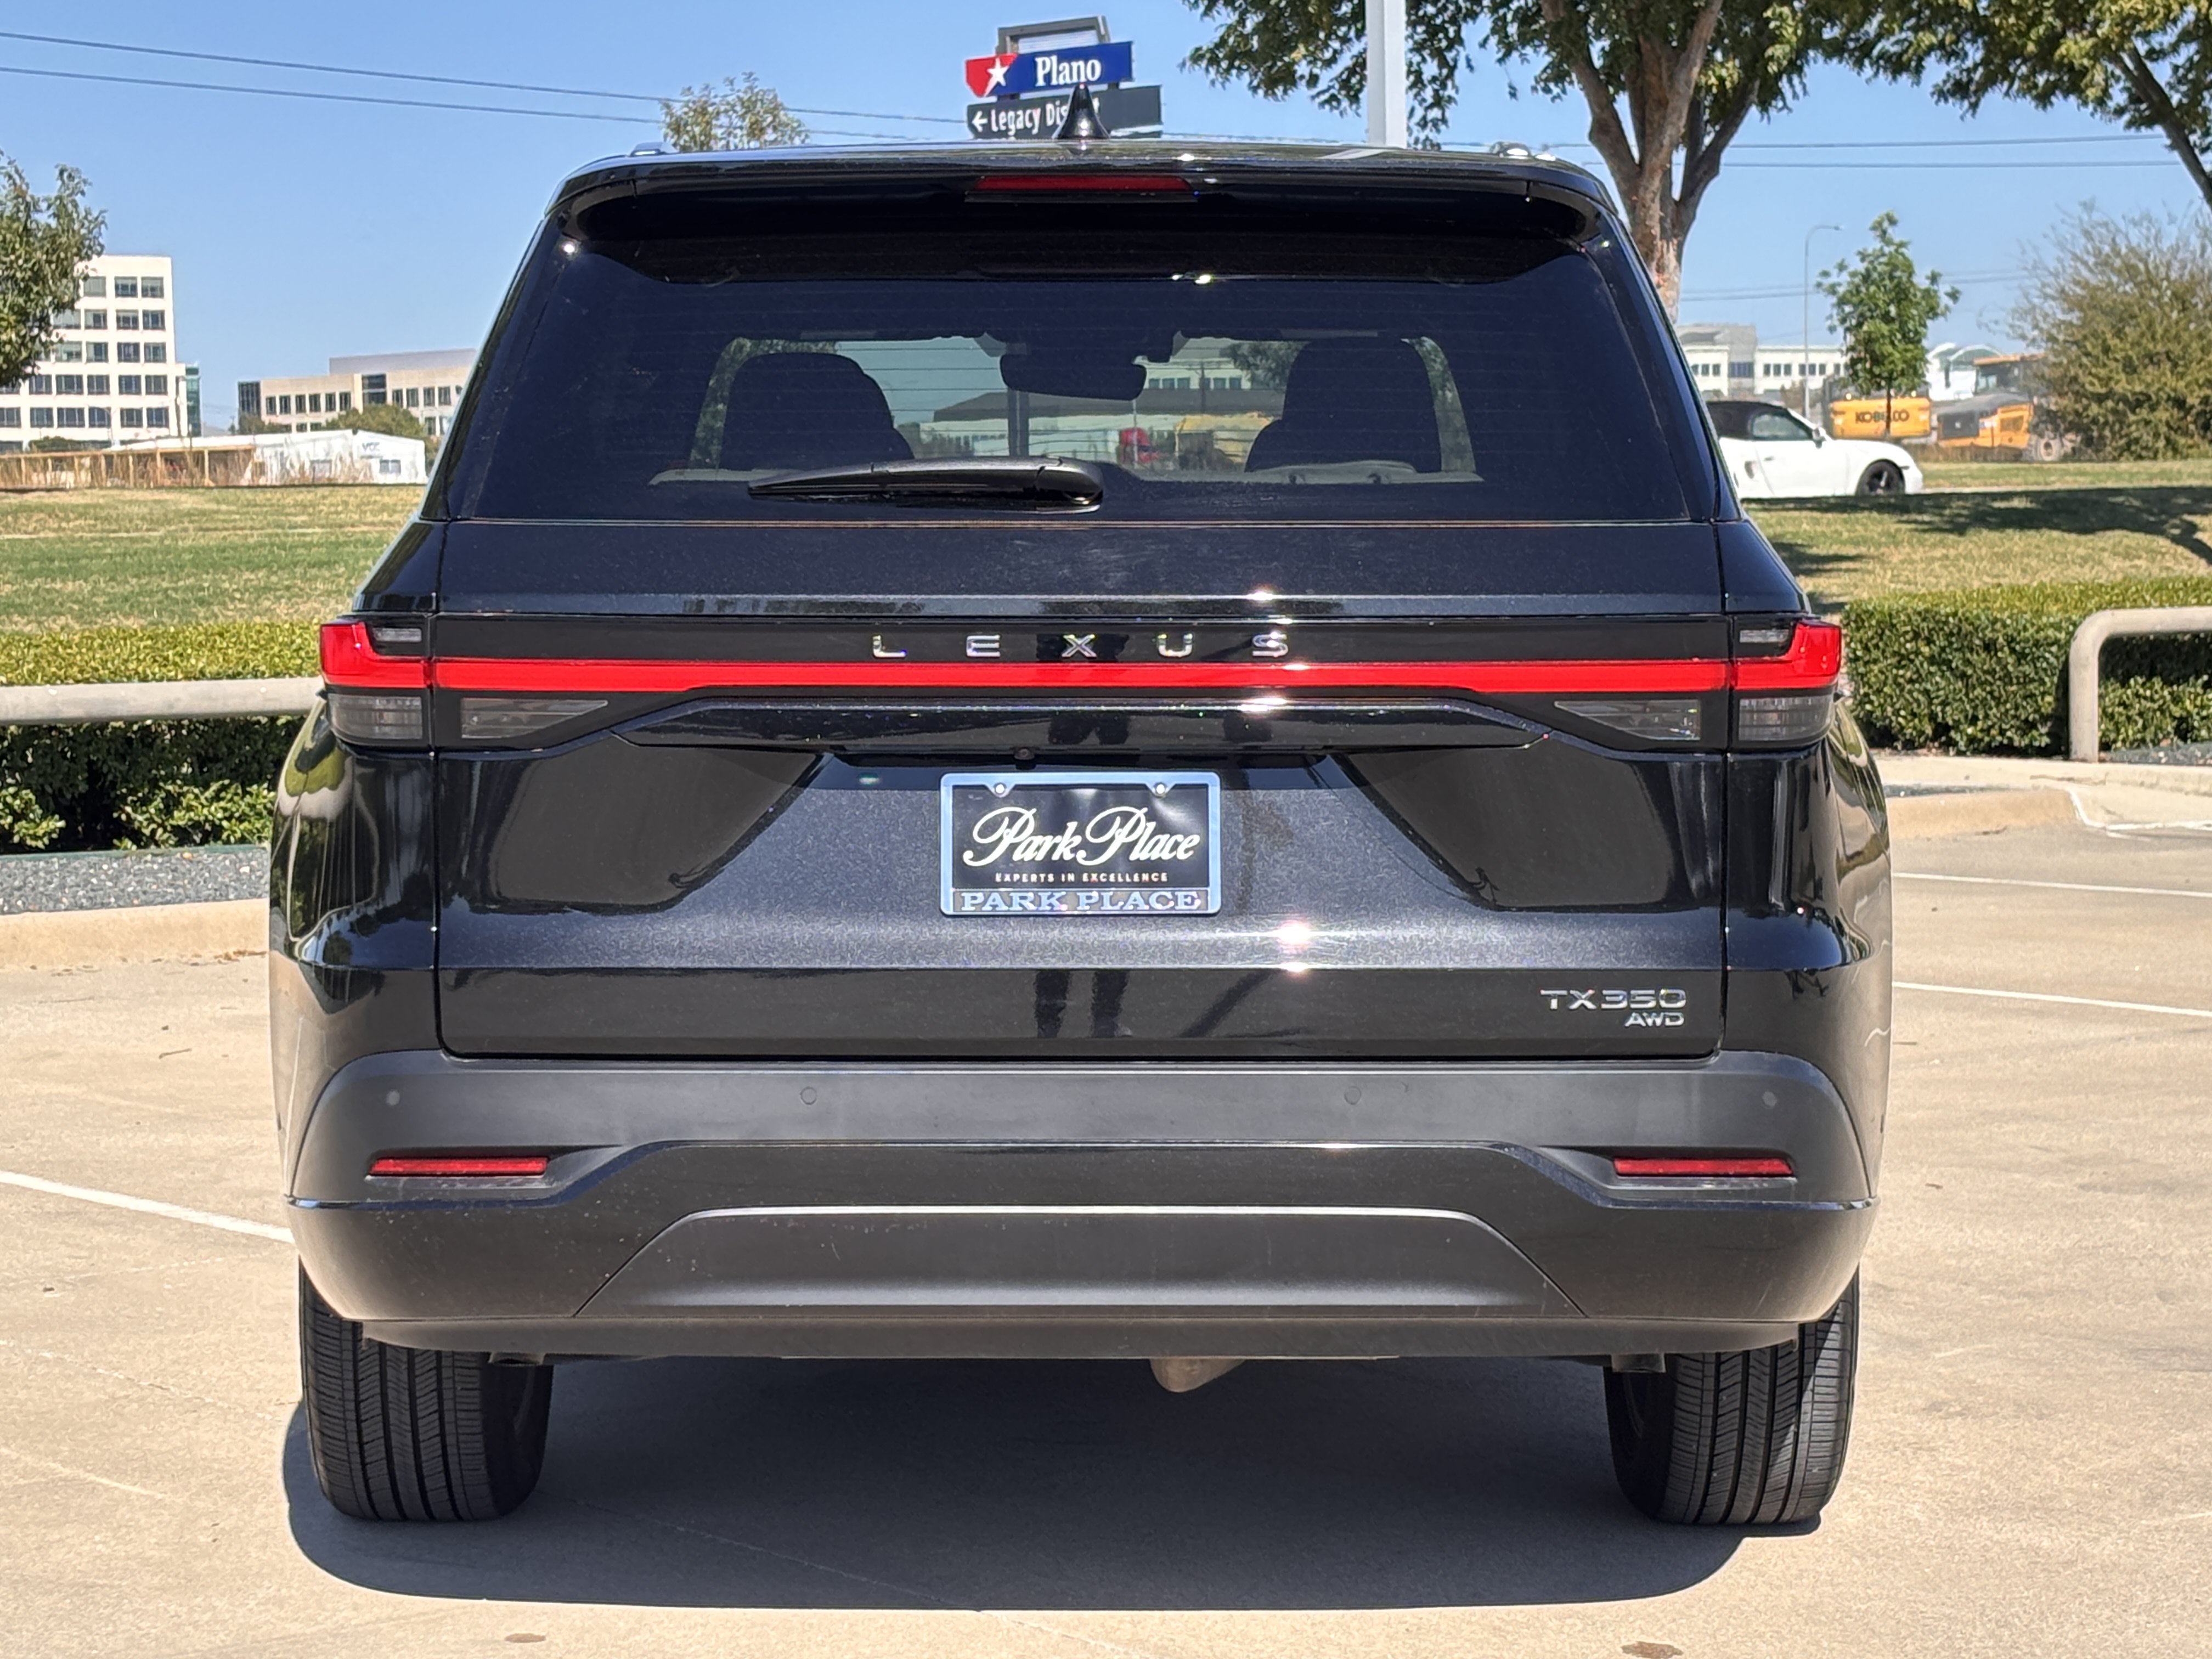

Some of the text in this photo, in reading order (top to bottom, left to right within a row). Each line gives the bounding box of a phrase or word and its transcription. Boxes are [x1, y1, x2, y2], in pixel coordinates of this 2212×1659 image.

[1035, 55, 1102, 87] Plano
[991, 108, 1041, 136] Legacy
[873, 631, 1289, 658] LEXUS
[963, 806, 1200, 866] Park Place
[995, 872, 1168, 883] EXPERTS IN EXCELLENCE
[961, 891, 1200, 911] PARK PLACE
[1624, 1012, 1685, 1026] AWD
